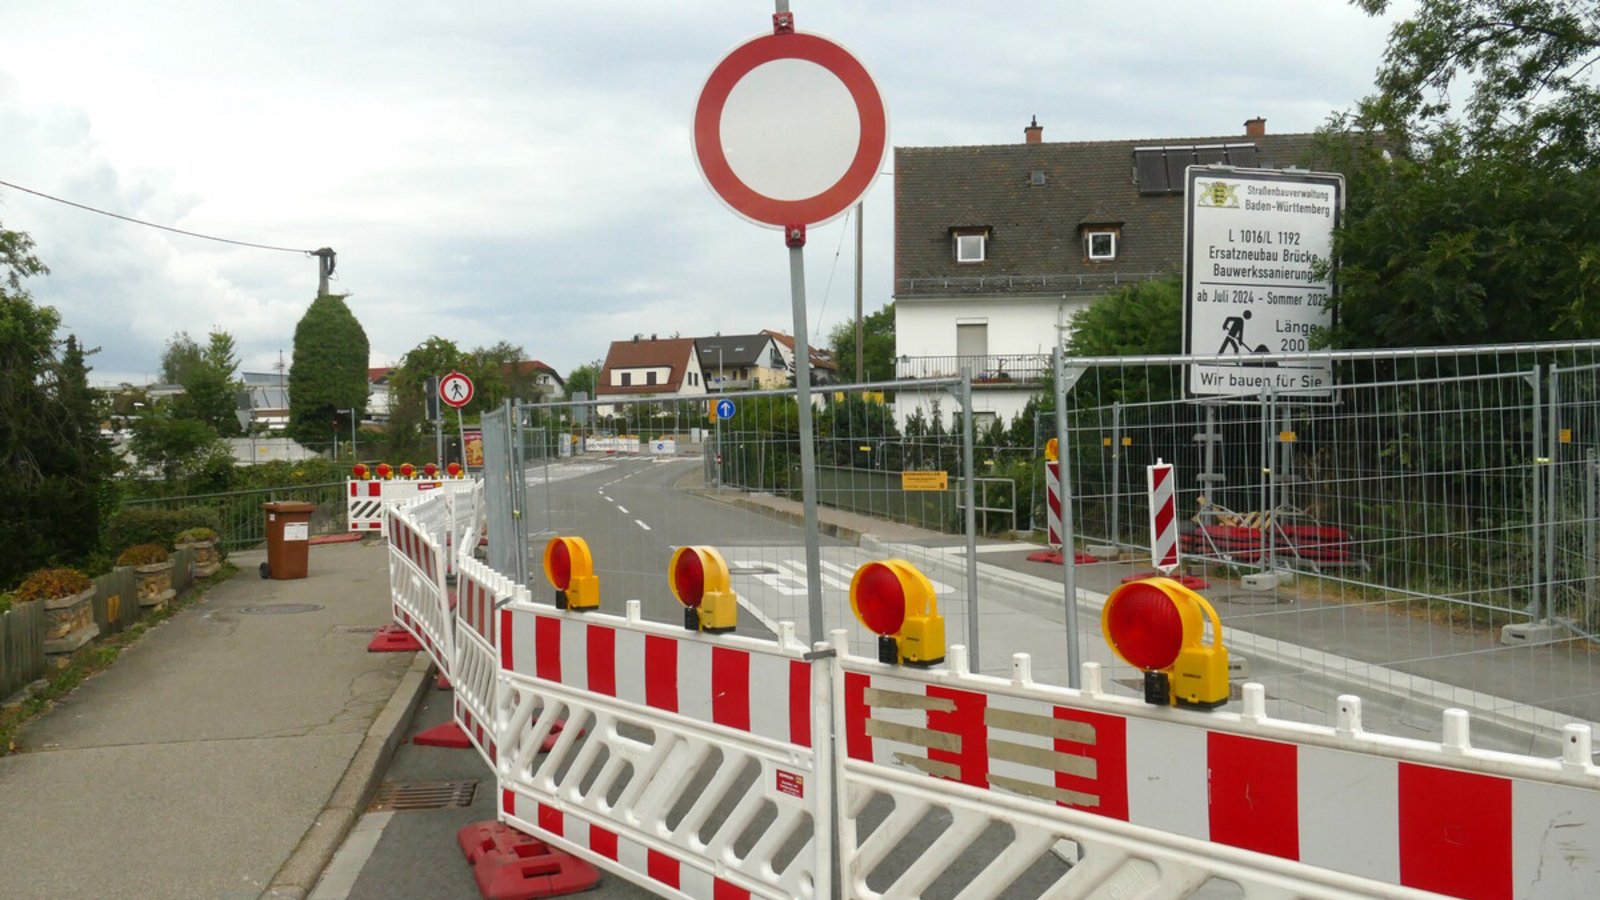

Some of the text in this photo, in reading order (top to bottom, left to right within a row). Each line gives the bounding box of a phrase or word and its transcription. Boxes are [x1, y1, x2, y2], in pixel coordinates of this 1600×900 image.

[1247, 186, 1329, 202] Straßenbauverwaltung
[1245, 200, 1330, 217] Baden-Württemberg
[1228, 229, 1301, 245] L 1016/L 1192
[1209, 245, 1278, 262] Ersatzneubau
[1213, 264, 1313, 283] Bauwerkssanierung
[1197, 289, 1208, 302] ab
[1212, 289, 1229, 303] Juli
[1232, 290, 1254, 304] 2024
[1267, 291, 1303, 306] Sommer
[1275, 319, 1317, 337] Länge
[1280, 338, 1305, 352] 200
[1200, 372, 1322, 388] Wir bauen für Sie
